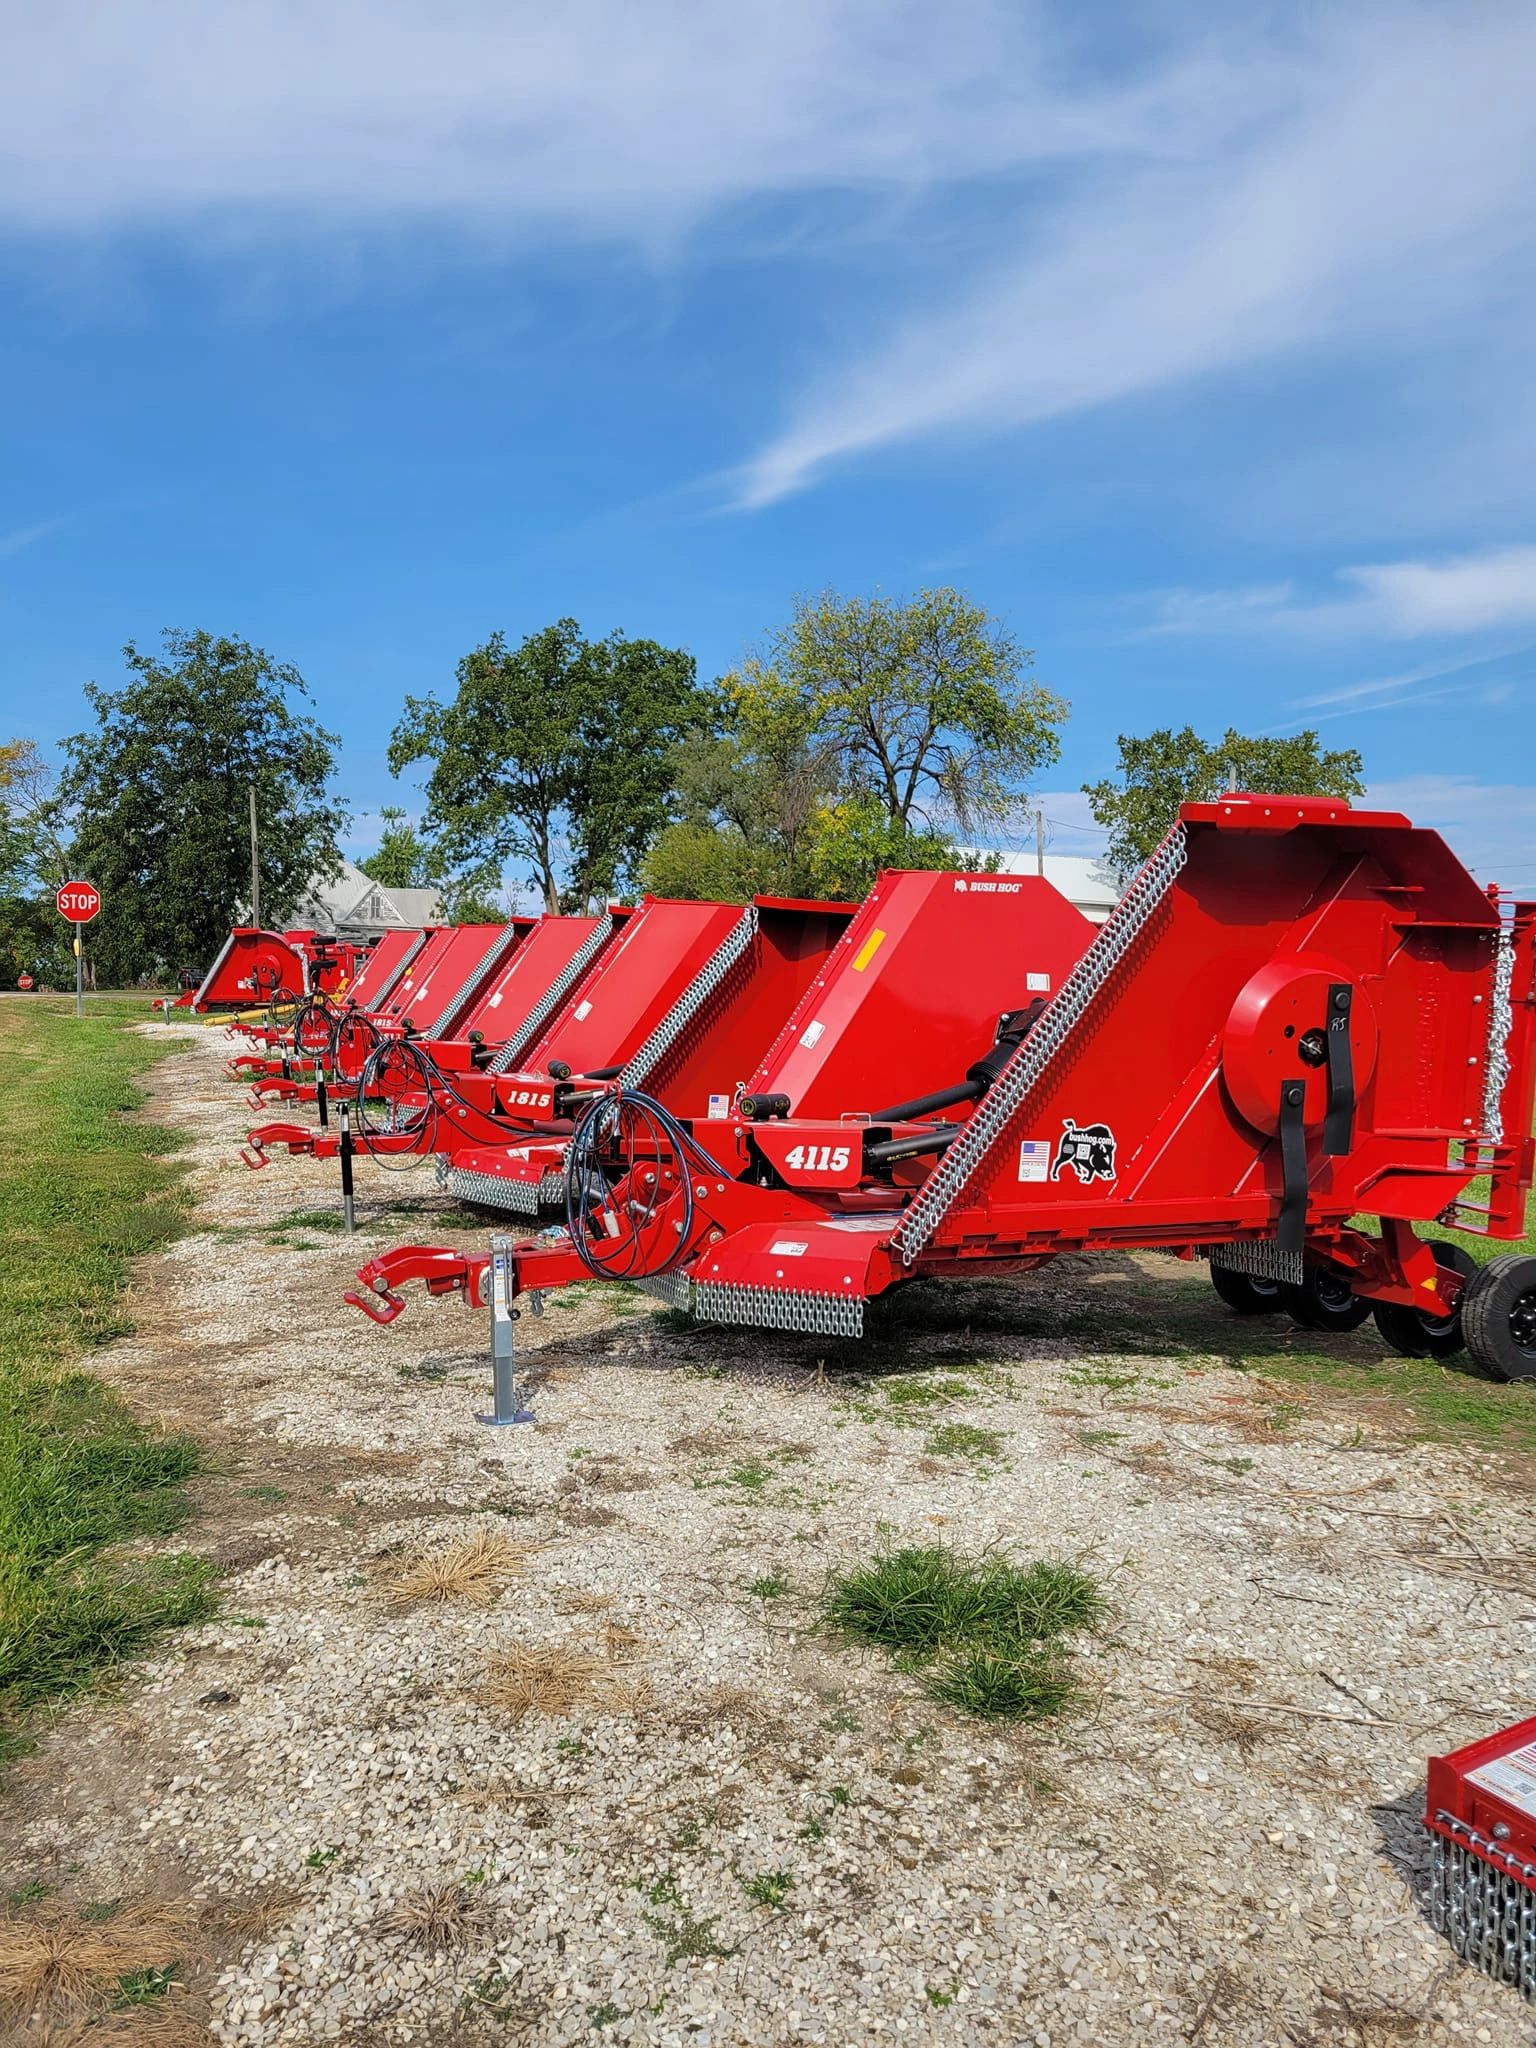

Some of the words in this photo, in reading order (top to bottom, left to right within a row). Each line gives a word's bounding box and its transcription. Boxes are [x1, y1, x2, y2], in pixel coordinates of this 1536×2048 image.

[970, 882, 997, 892] BUSH
[60, 894, 97, 910] STOP
[507, 1090, 551, 1107] 1815
[1069, 1133, 1112, 1145] bushhog.com
[785, 1145, 850, 1171] 4115
